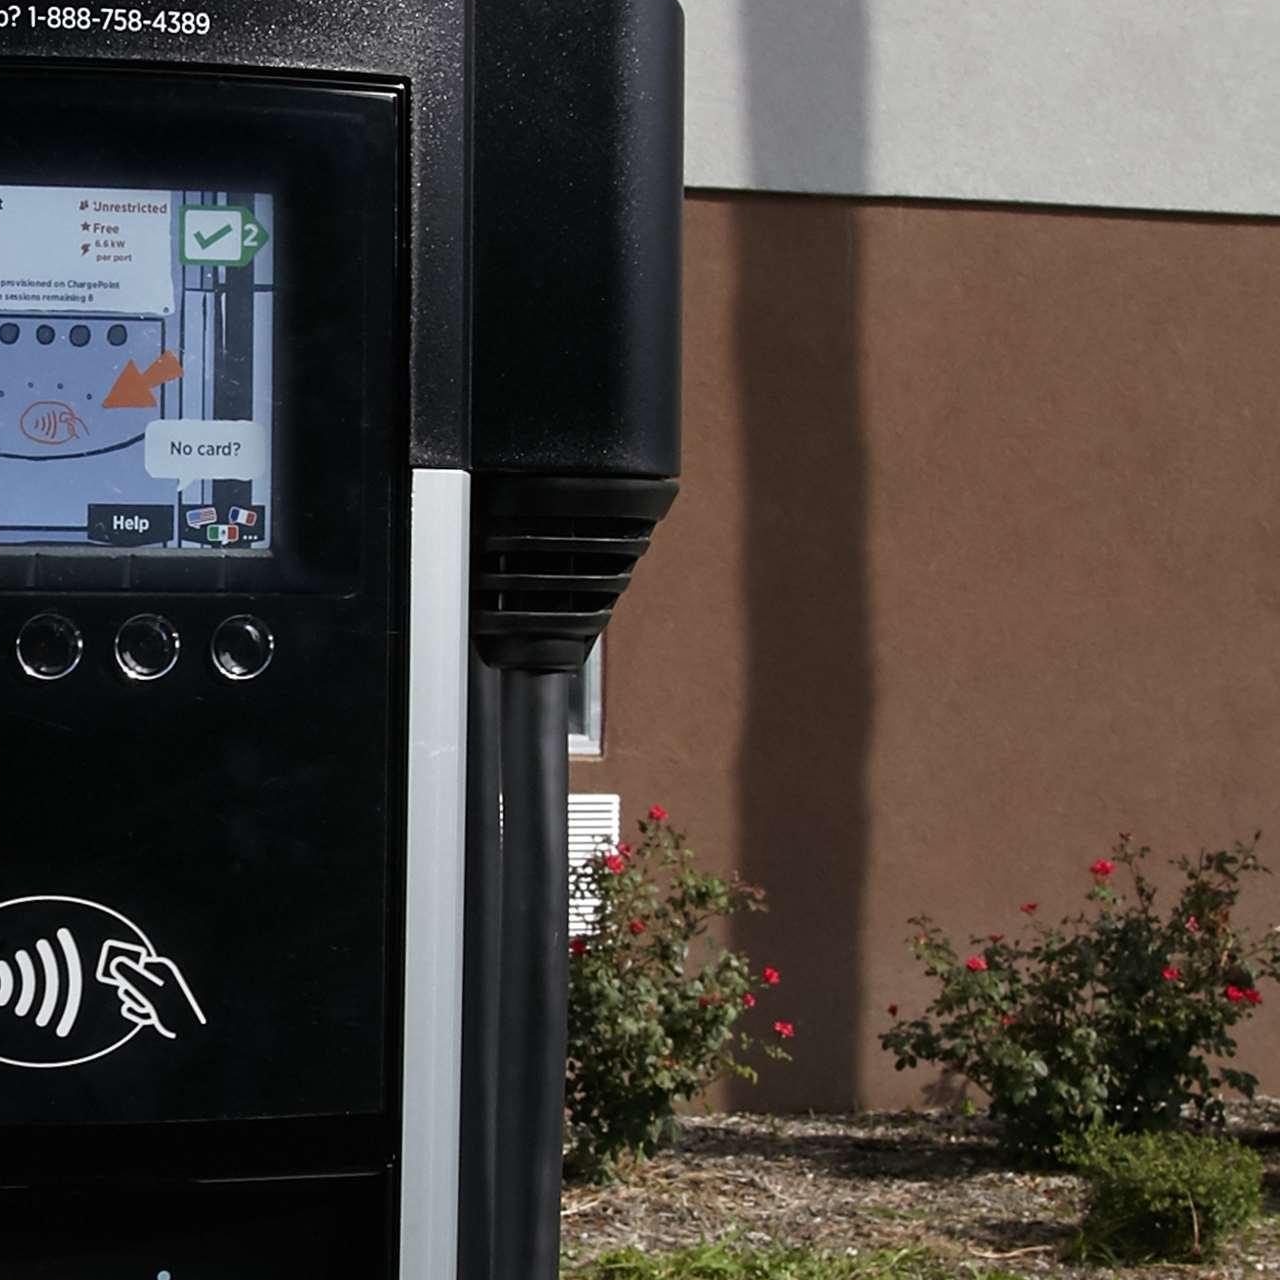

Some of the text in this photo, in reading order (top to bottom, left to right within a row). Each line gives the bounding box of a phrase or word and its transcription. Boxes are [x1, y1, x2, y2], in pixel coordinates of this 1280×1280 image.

[28, 5, 210, 35] 1-888-758-4389
[93, 201, 168, 214] Unrestricted
[93, 222, 120, 234] Free
[243, 224, 259, 247] 2
[96, 253, 133, 263] per port
[0, 278, 52, 290] provisioned
[53, 280, 66, 288] on
[67, 280, 120, 290] ChargePoint
[4, 291, 40, 302] sessions
[41, 292, 86, 304] remaining
[170, 441, 242, 457] No card?
[112, 515, 150, 533] Help
